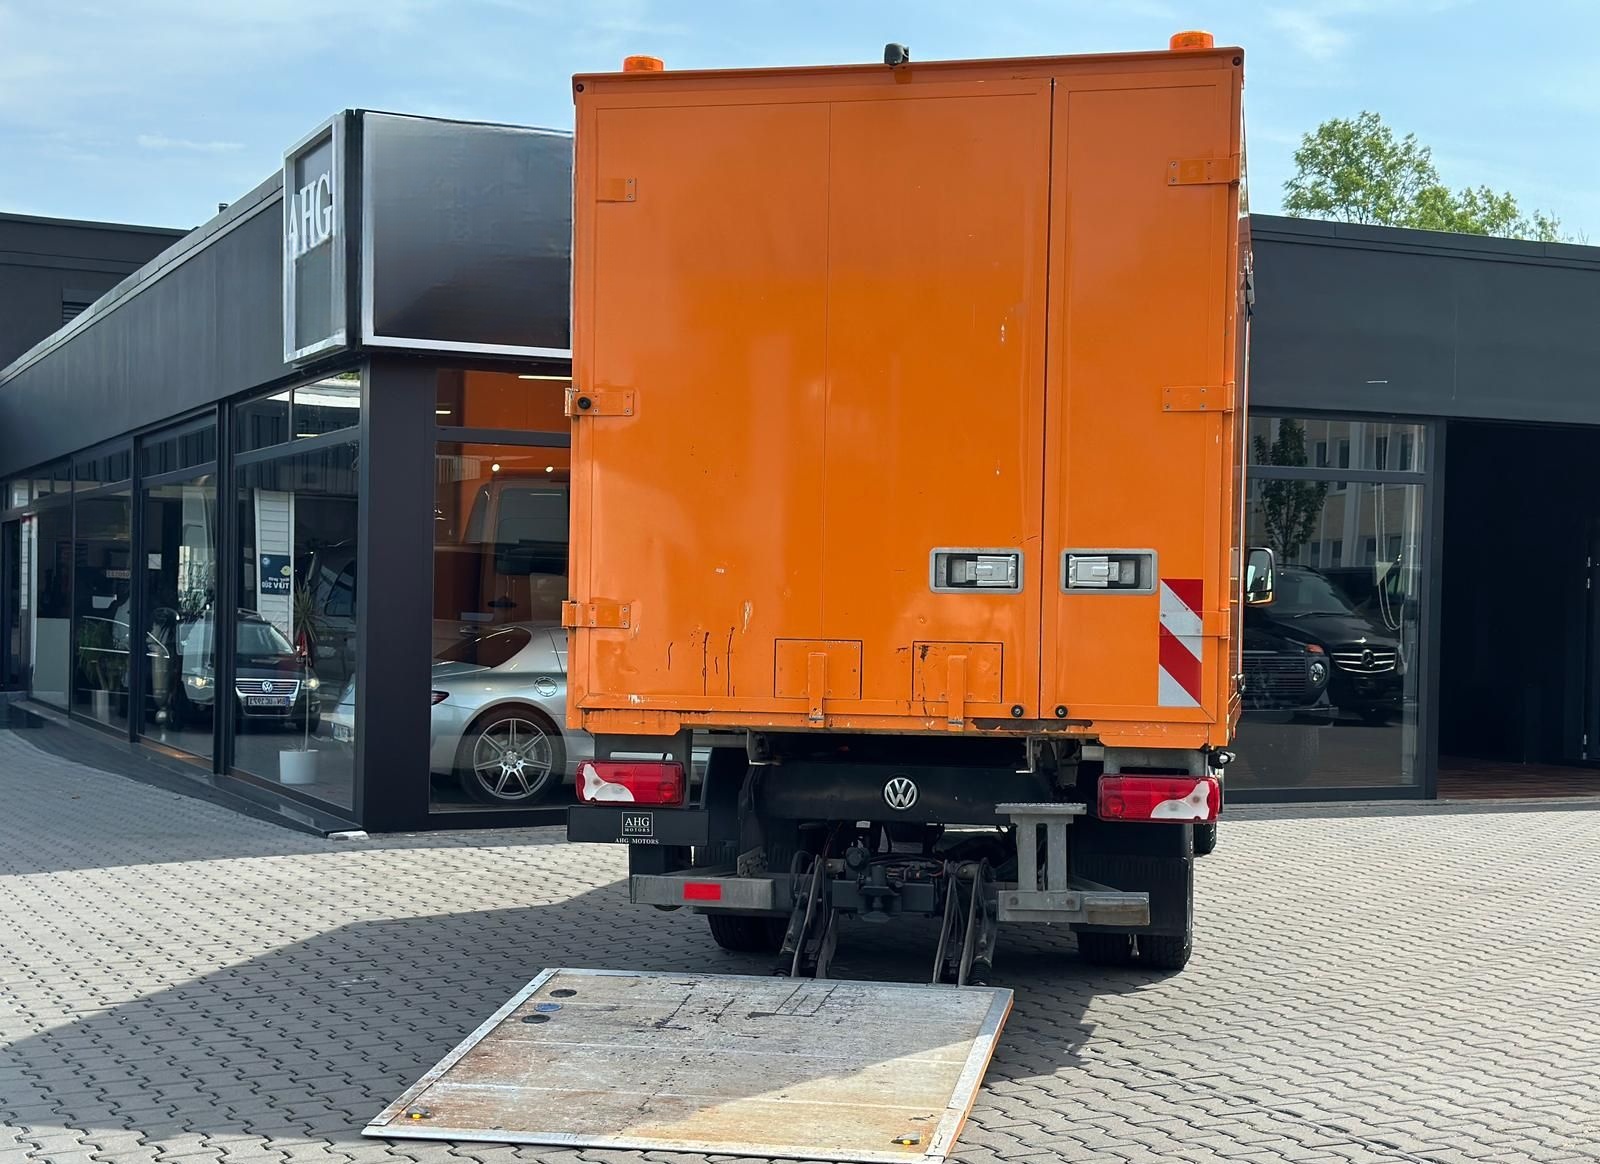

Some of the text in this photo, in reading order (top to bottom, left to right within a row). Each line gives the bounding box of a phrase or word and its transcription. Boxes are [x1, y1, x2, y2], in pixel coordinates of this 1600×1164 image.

[287, 169, 333, 260] AHG
[884, 777, 918, 810] VW
[624, 816, 650, 827] AHG
